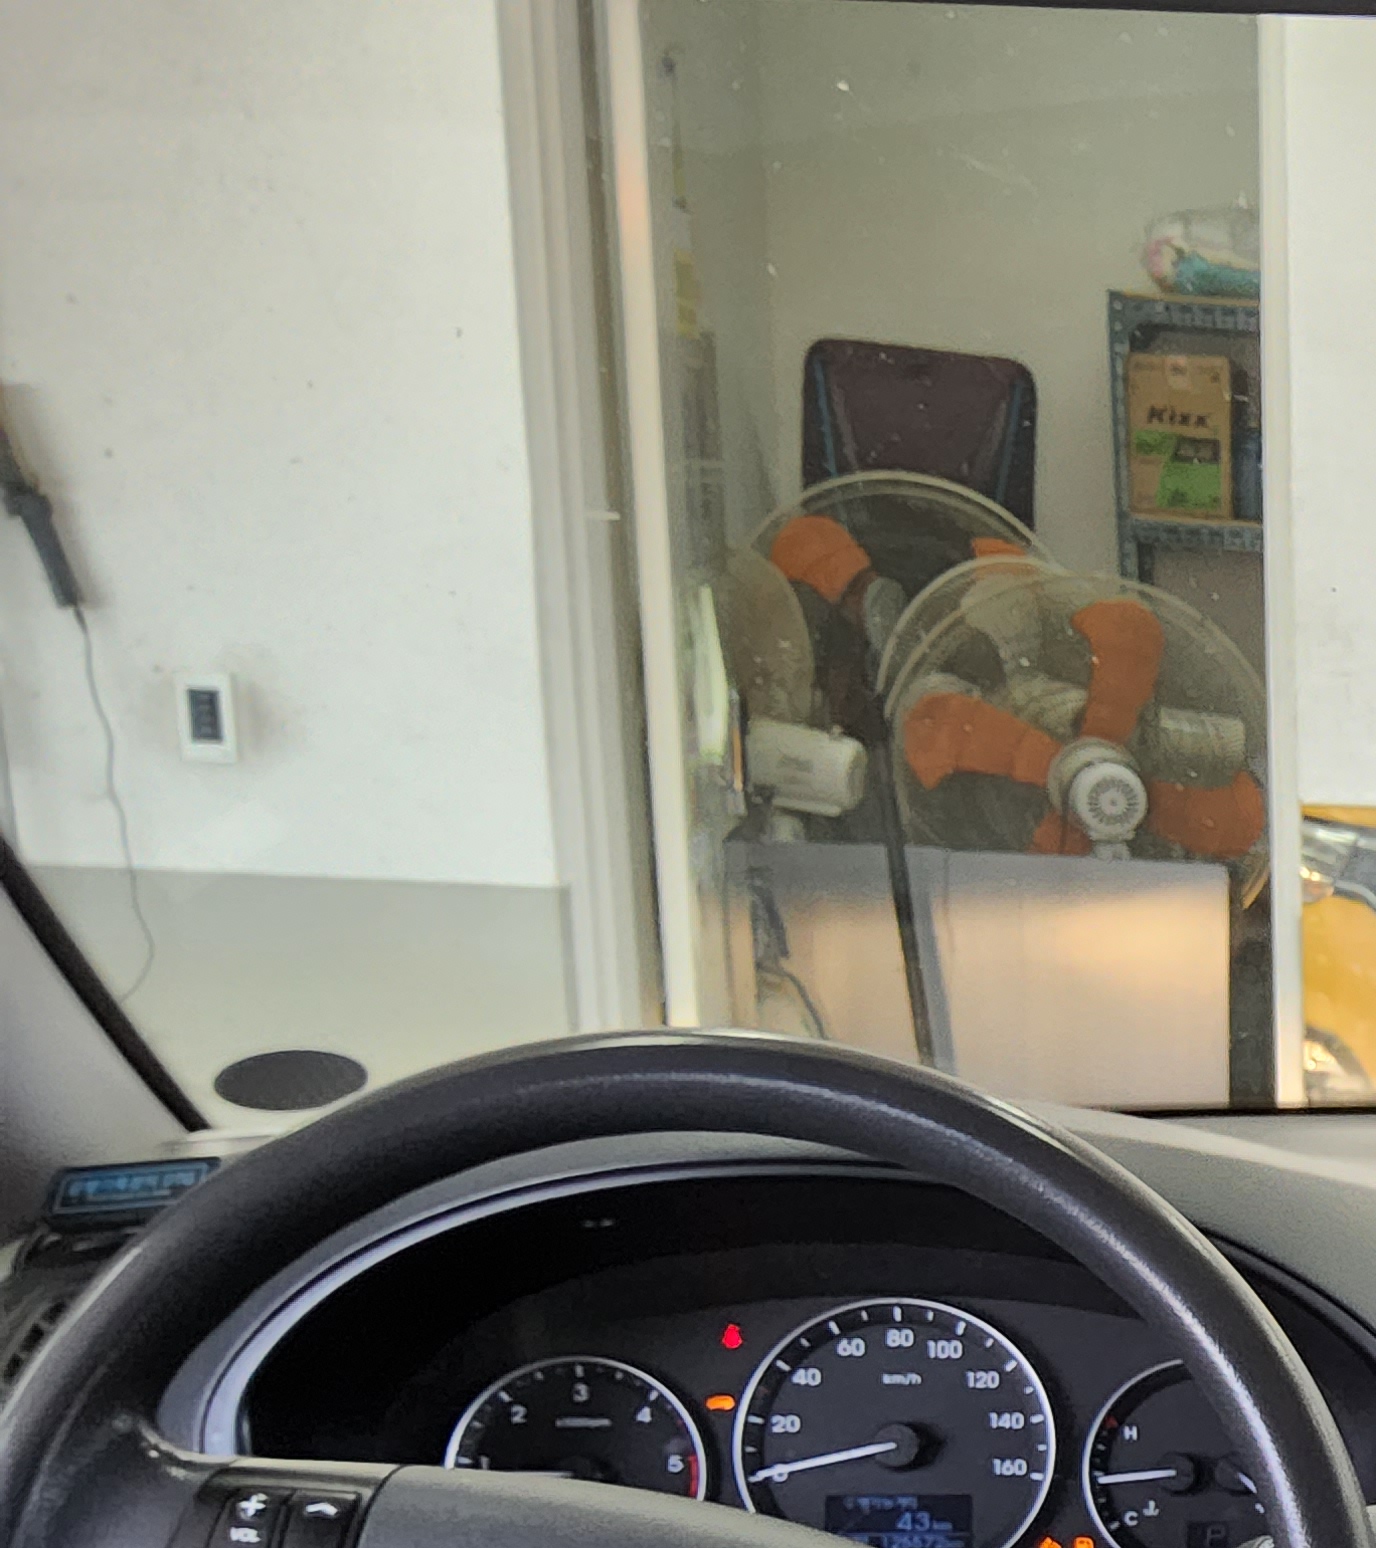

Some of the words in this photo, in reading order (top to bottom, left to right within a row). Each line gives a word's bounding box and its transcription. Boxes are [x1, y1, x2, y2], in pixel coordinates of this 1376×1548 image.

[836, 1337, 866, 1358] 60
[885, 1328, 915, 1348] 80
[926, 1340, 964, 1360] 100
[790, 1367, 822, 1387] 40
[881, 1372, 922, 1385] km/h
[965, 1370, 1001, 1389] 120
[572, 1382, 590, 1402] 3
[510, 1404, 528, 1424] 2
[634, 1405, 653, 1424] 4
[770, 1414, 801, 1434] 20
[988, 1411, 1025, 1430] 140
[1122, 1425, 1139, 1441] H
[667, 1454, 685, 1474] 5
[991, 1458, 1028, 1477] 160
[896, 1510, 931, 1532] 43
[1123, 1510, 1139, 1527] C
